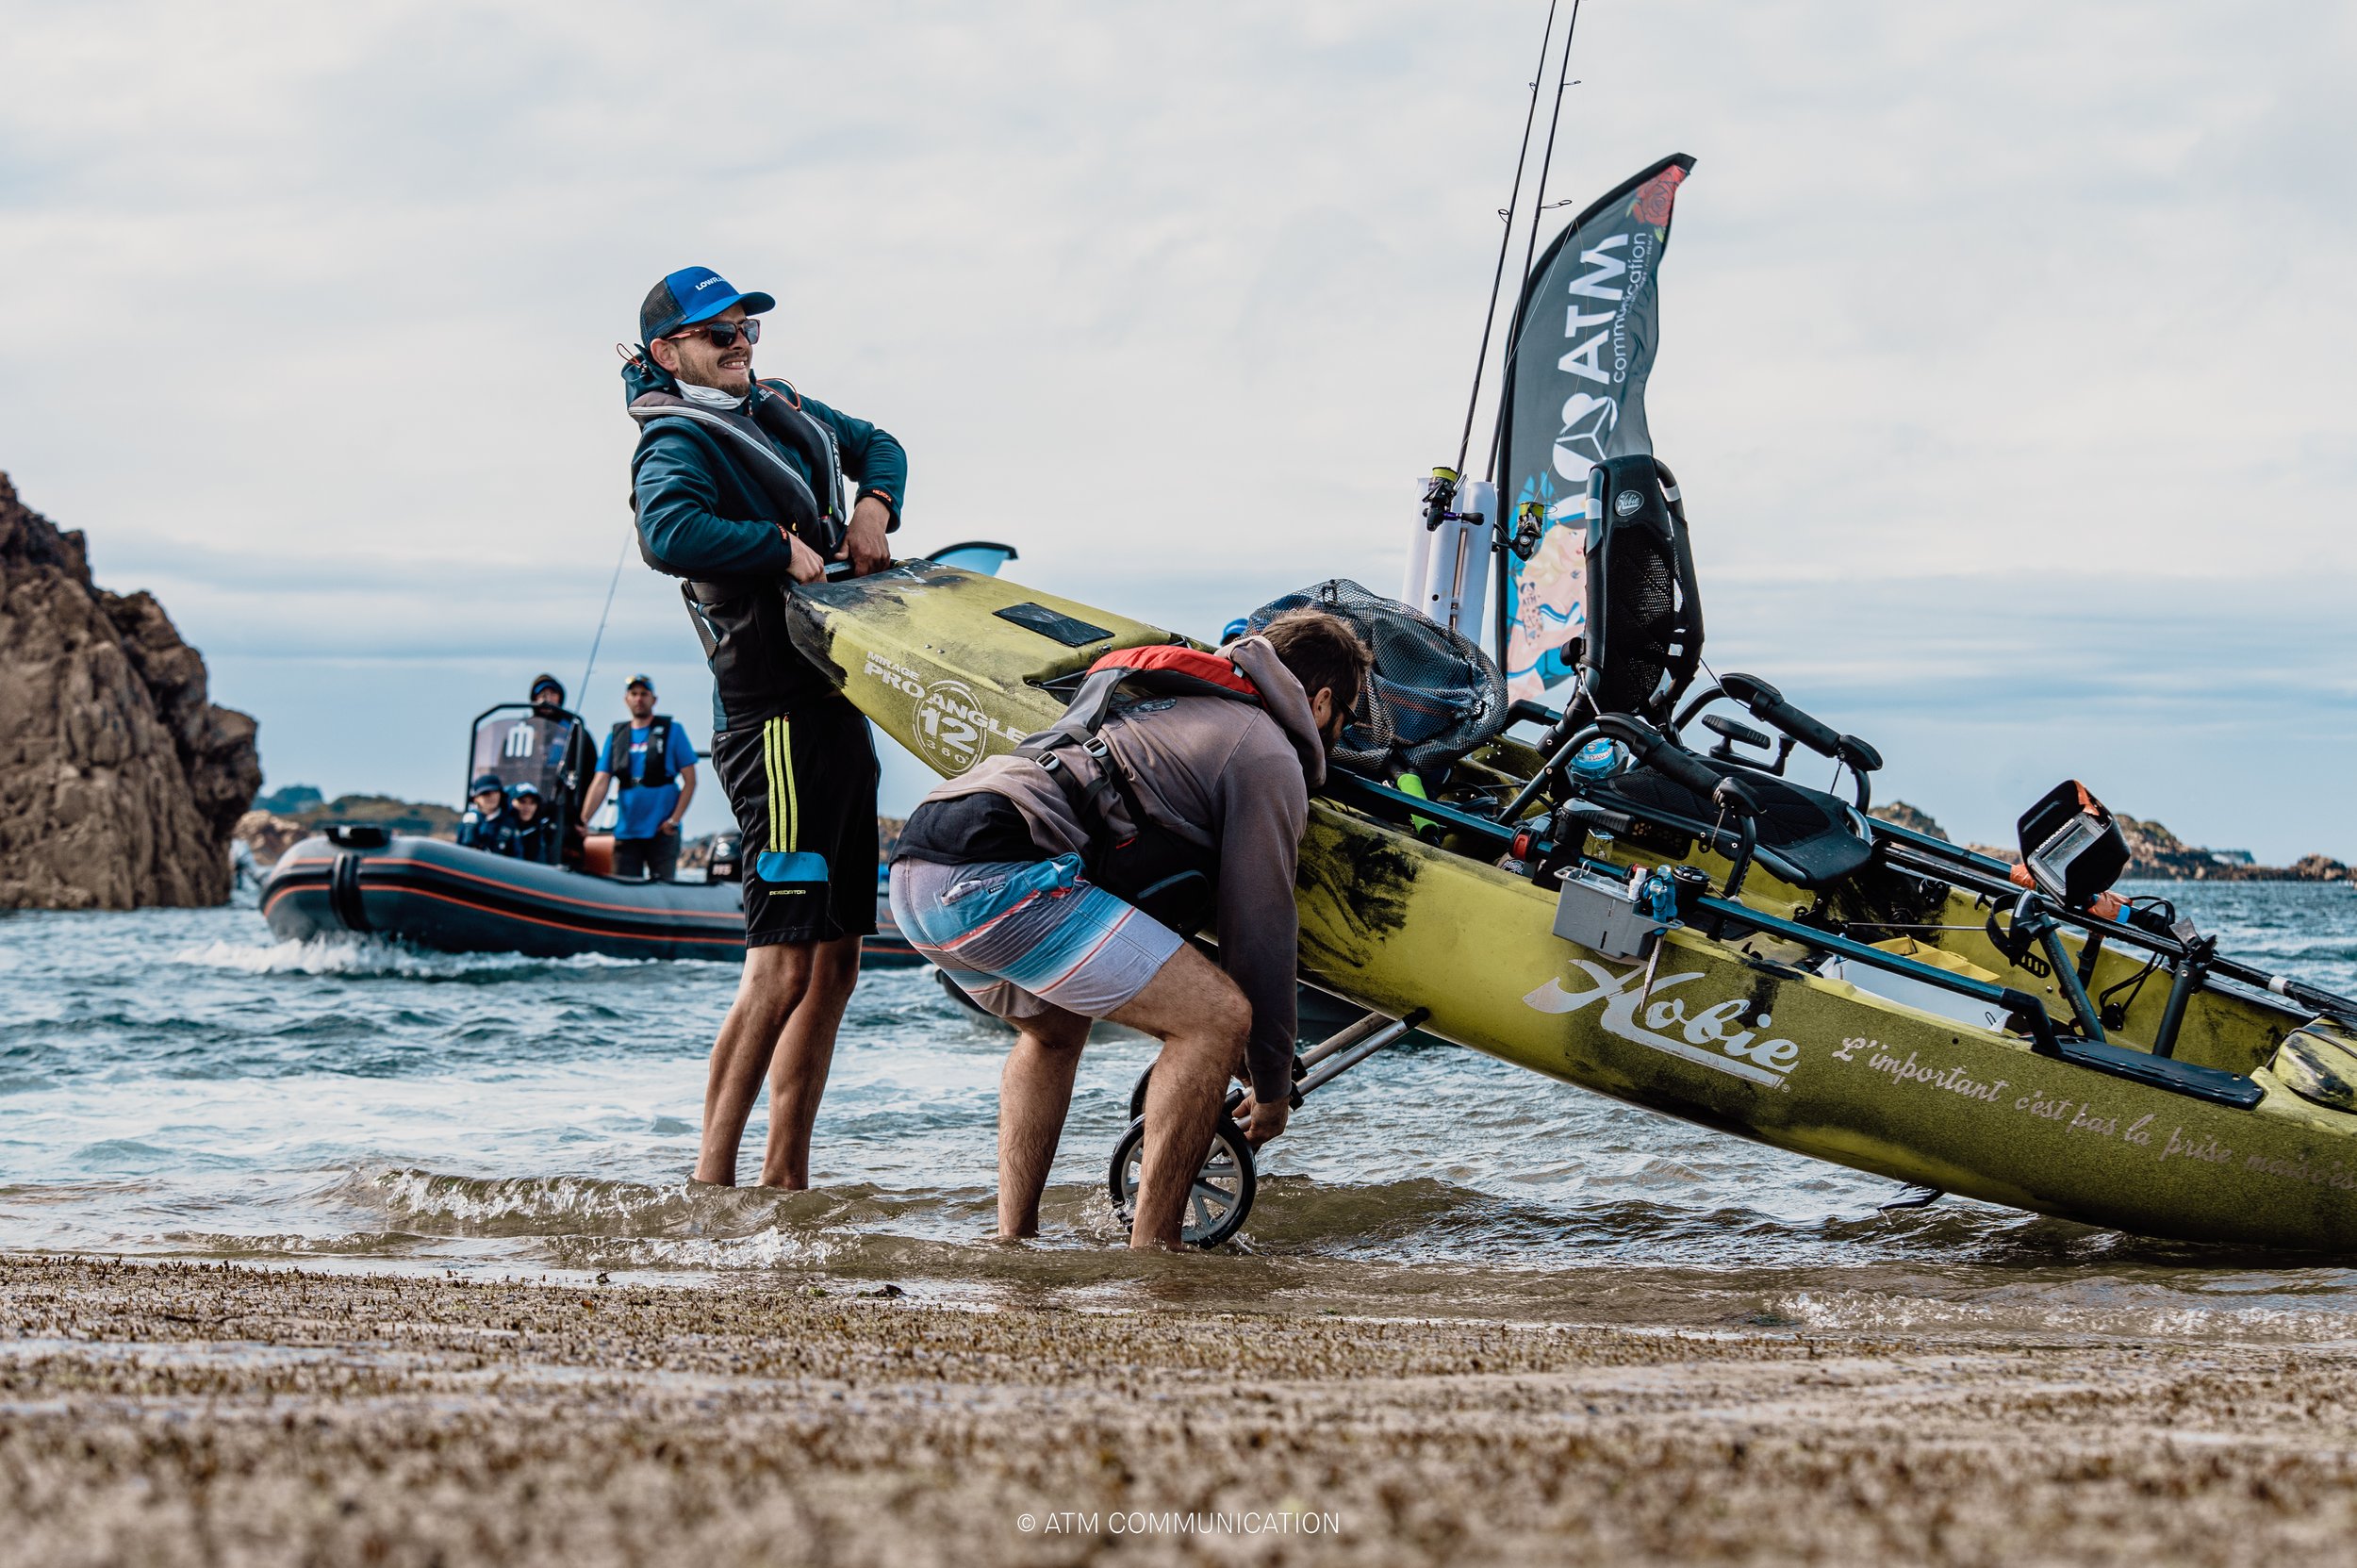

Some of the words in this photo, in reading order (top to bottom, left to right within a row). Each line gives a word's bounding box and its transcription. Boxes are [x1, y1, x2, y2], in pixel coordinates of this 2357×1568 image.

[695, 276, 724, 291] LOWRA
[1558, 233, 1629, 385] ATM
[1613, 232, 1647, 384] communication
[864, 660, 926, 699] PRO
[925, 692, 1029, 745] ANGLE
[867, 651, 920, 683] MIRAGE
[920, 707, 978, 755] 12
[2035, 817, 2075, 853] LOWRANCE
[1522, 950, 1801, 1090] Hobie
[1832, 1036, 2009, 1102] L'important
[2015, 1090, 2073, 1120] c'est
[2066, 1102, 2118, 1135] pas
[2124, 1114, 2157, 1147] la
[2159, 1127, 2233, 1163] prise
[2311, 1161, 2357, 1191] c'es
